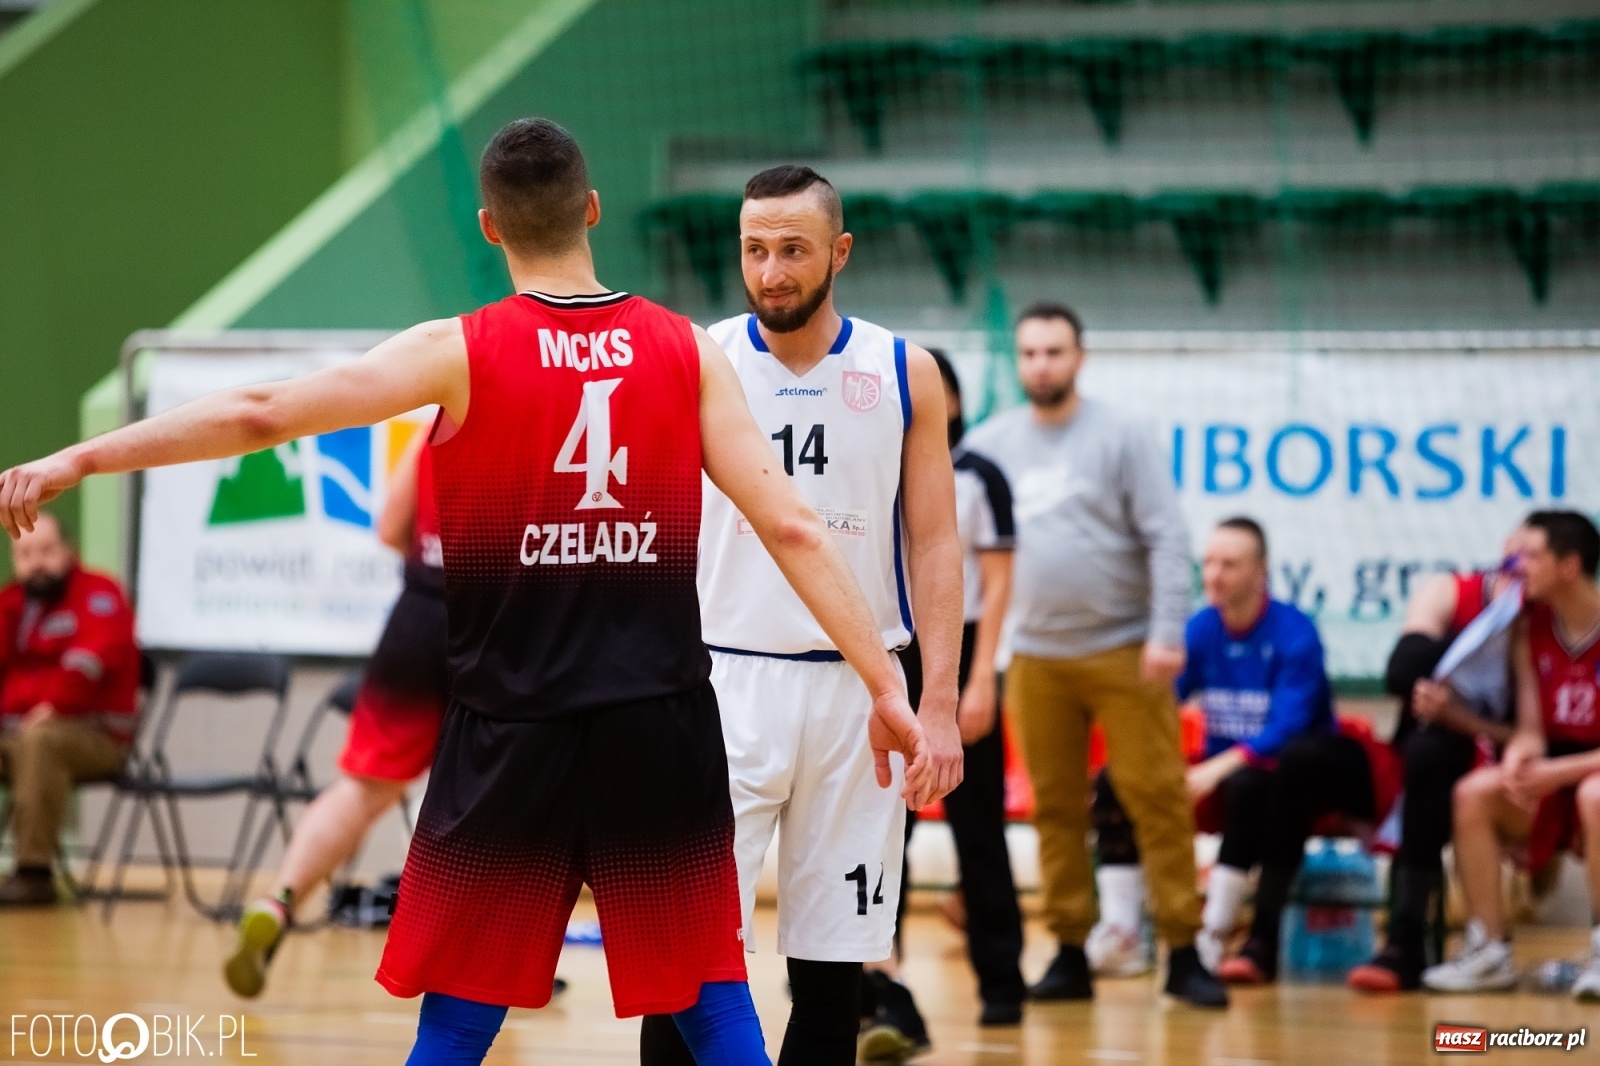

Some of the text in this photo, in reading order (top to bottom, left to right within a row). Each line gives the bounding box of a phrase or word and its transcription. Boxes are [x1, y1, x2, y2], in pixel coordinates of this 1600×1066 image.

[537, 328, 634, 373] MCKS
[775, 387, 823, 397] stelman
[553, 377, 628, 511] 4
[771, 424, 829, 476] 14
[520, 511, 657, 566] CZELADŹ
[823, 519, 851, 531] KA
